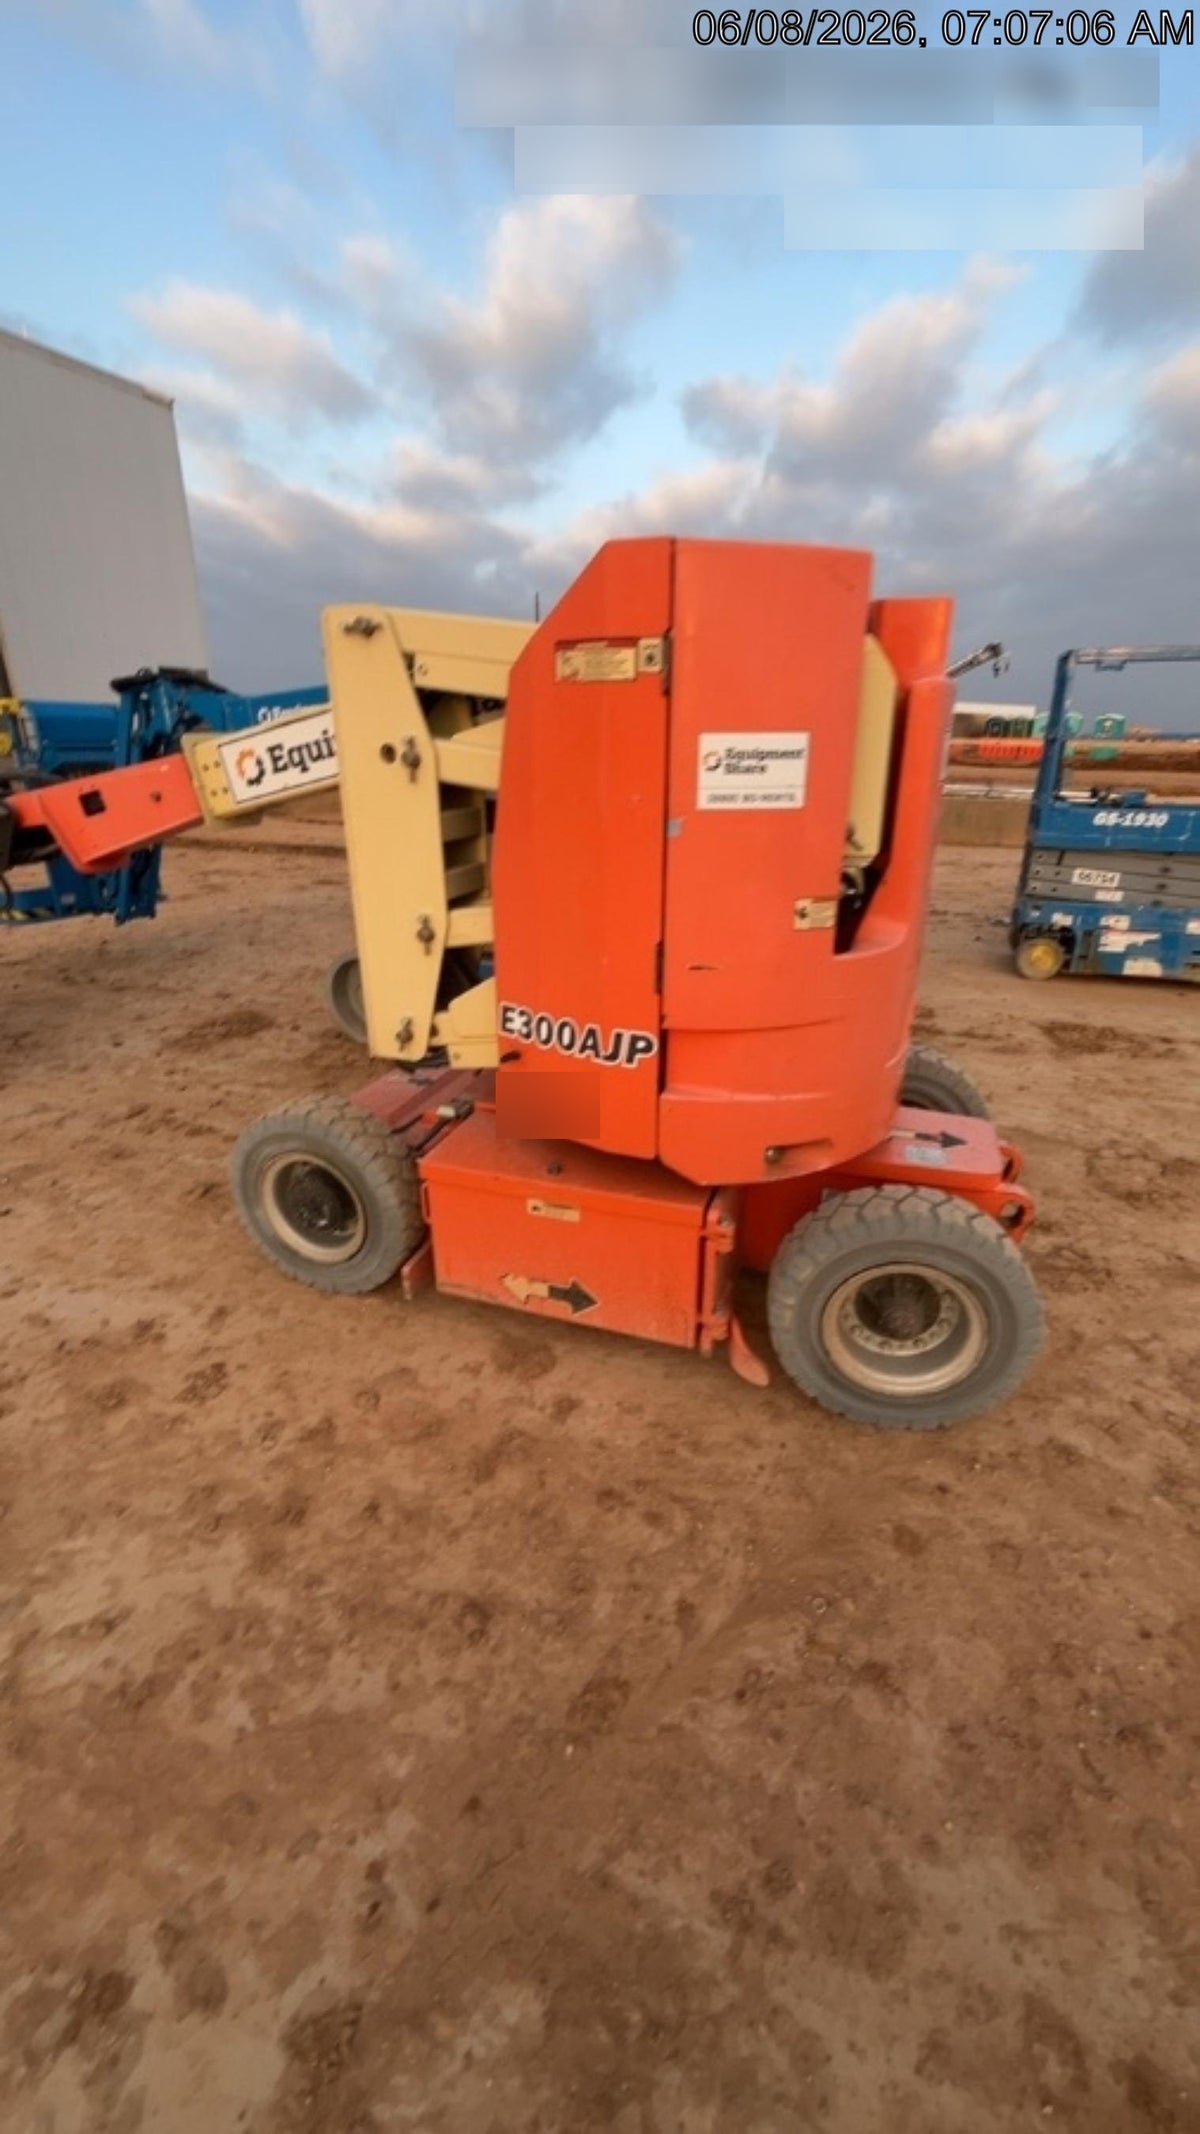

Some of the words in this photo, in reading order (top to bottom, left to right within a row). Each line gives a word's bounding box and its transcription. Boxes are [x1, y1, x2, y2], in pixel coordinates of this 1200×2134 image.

[266, 727, 337, 774] Equi
[724, 746, 805, 761] Equipment
[723, 762, 768, 775] Share
[499, 1001, 658, 1068] E300AJP
